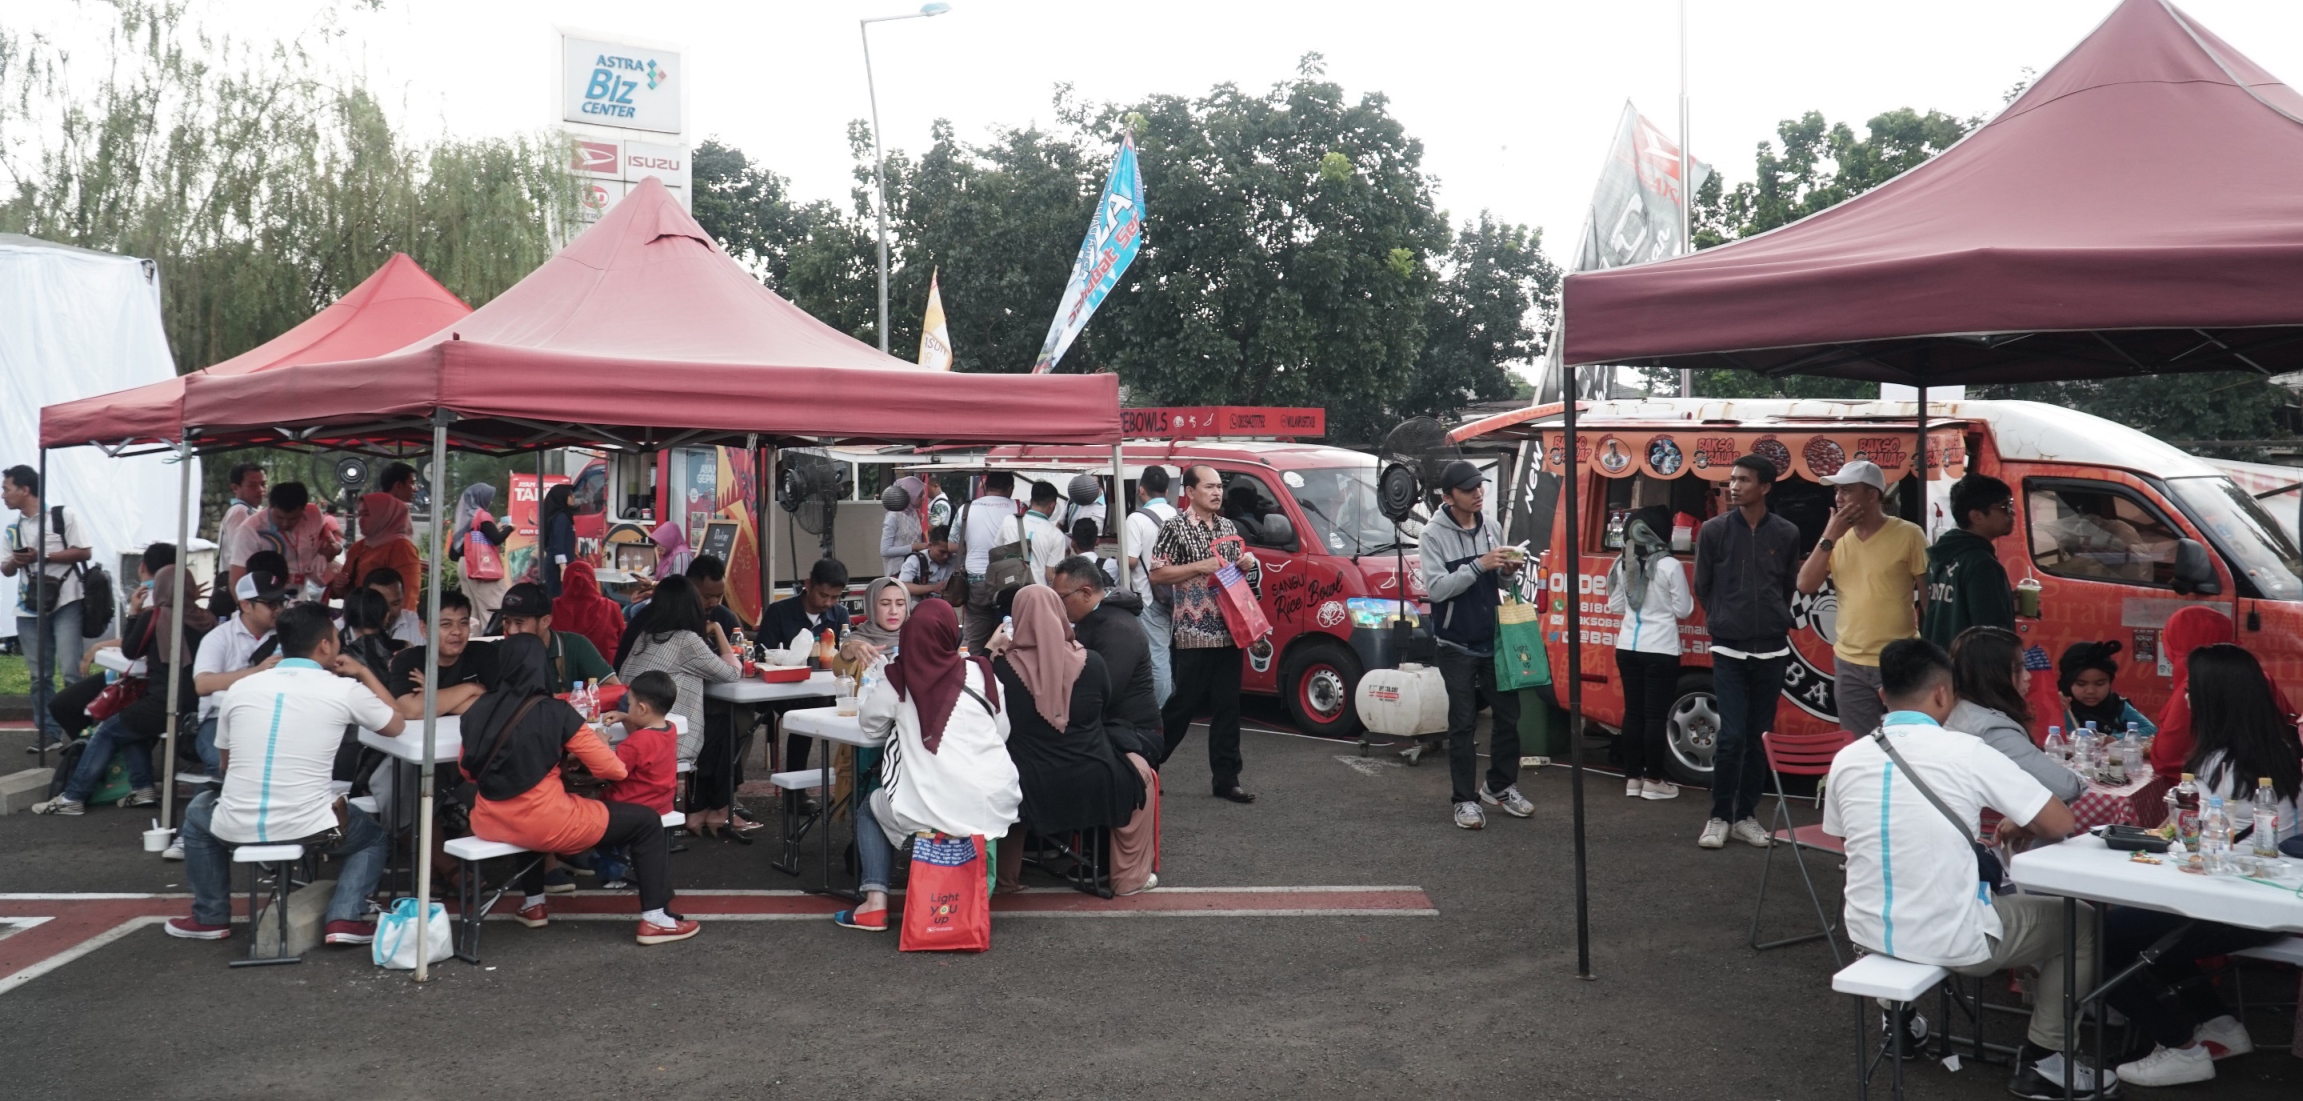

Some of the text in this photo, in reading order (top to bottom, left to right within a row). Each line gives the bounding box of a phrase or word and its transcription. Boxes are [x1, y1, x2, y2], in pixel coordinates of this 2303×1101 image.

[596, 54, 645, 72] ASTRA
[581, 101, 636, 119] CENTER
[627, 155, 680, 171] ISUZU
[1119, 411, 1168, 433] EBOWLS
[1696, 437, 1736, 452] BAKSO
[1857, 437, 1901, 453] BAKSO
[1524, 440, 1544, 515] New
[1271, 573, 1306, 597] SANGU
[1274, 595, 1304, 624] Rice
[1307, 570, 1344, 608] Bowl
[930, 892, 960, 905] Light
[934, 916, 949, 925] up
